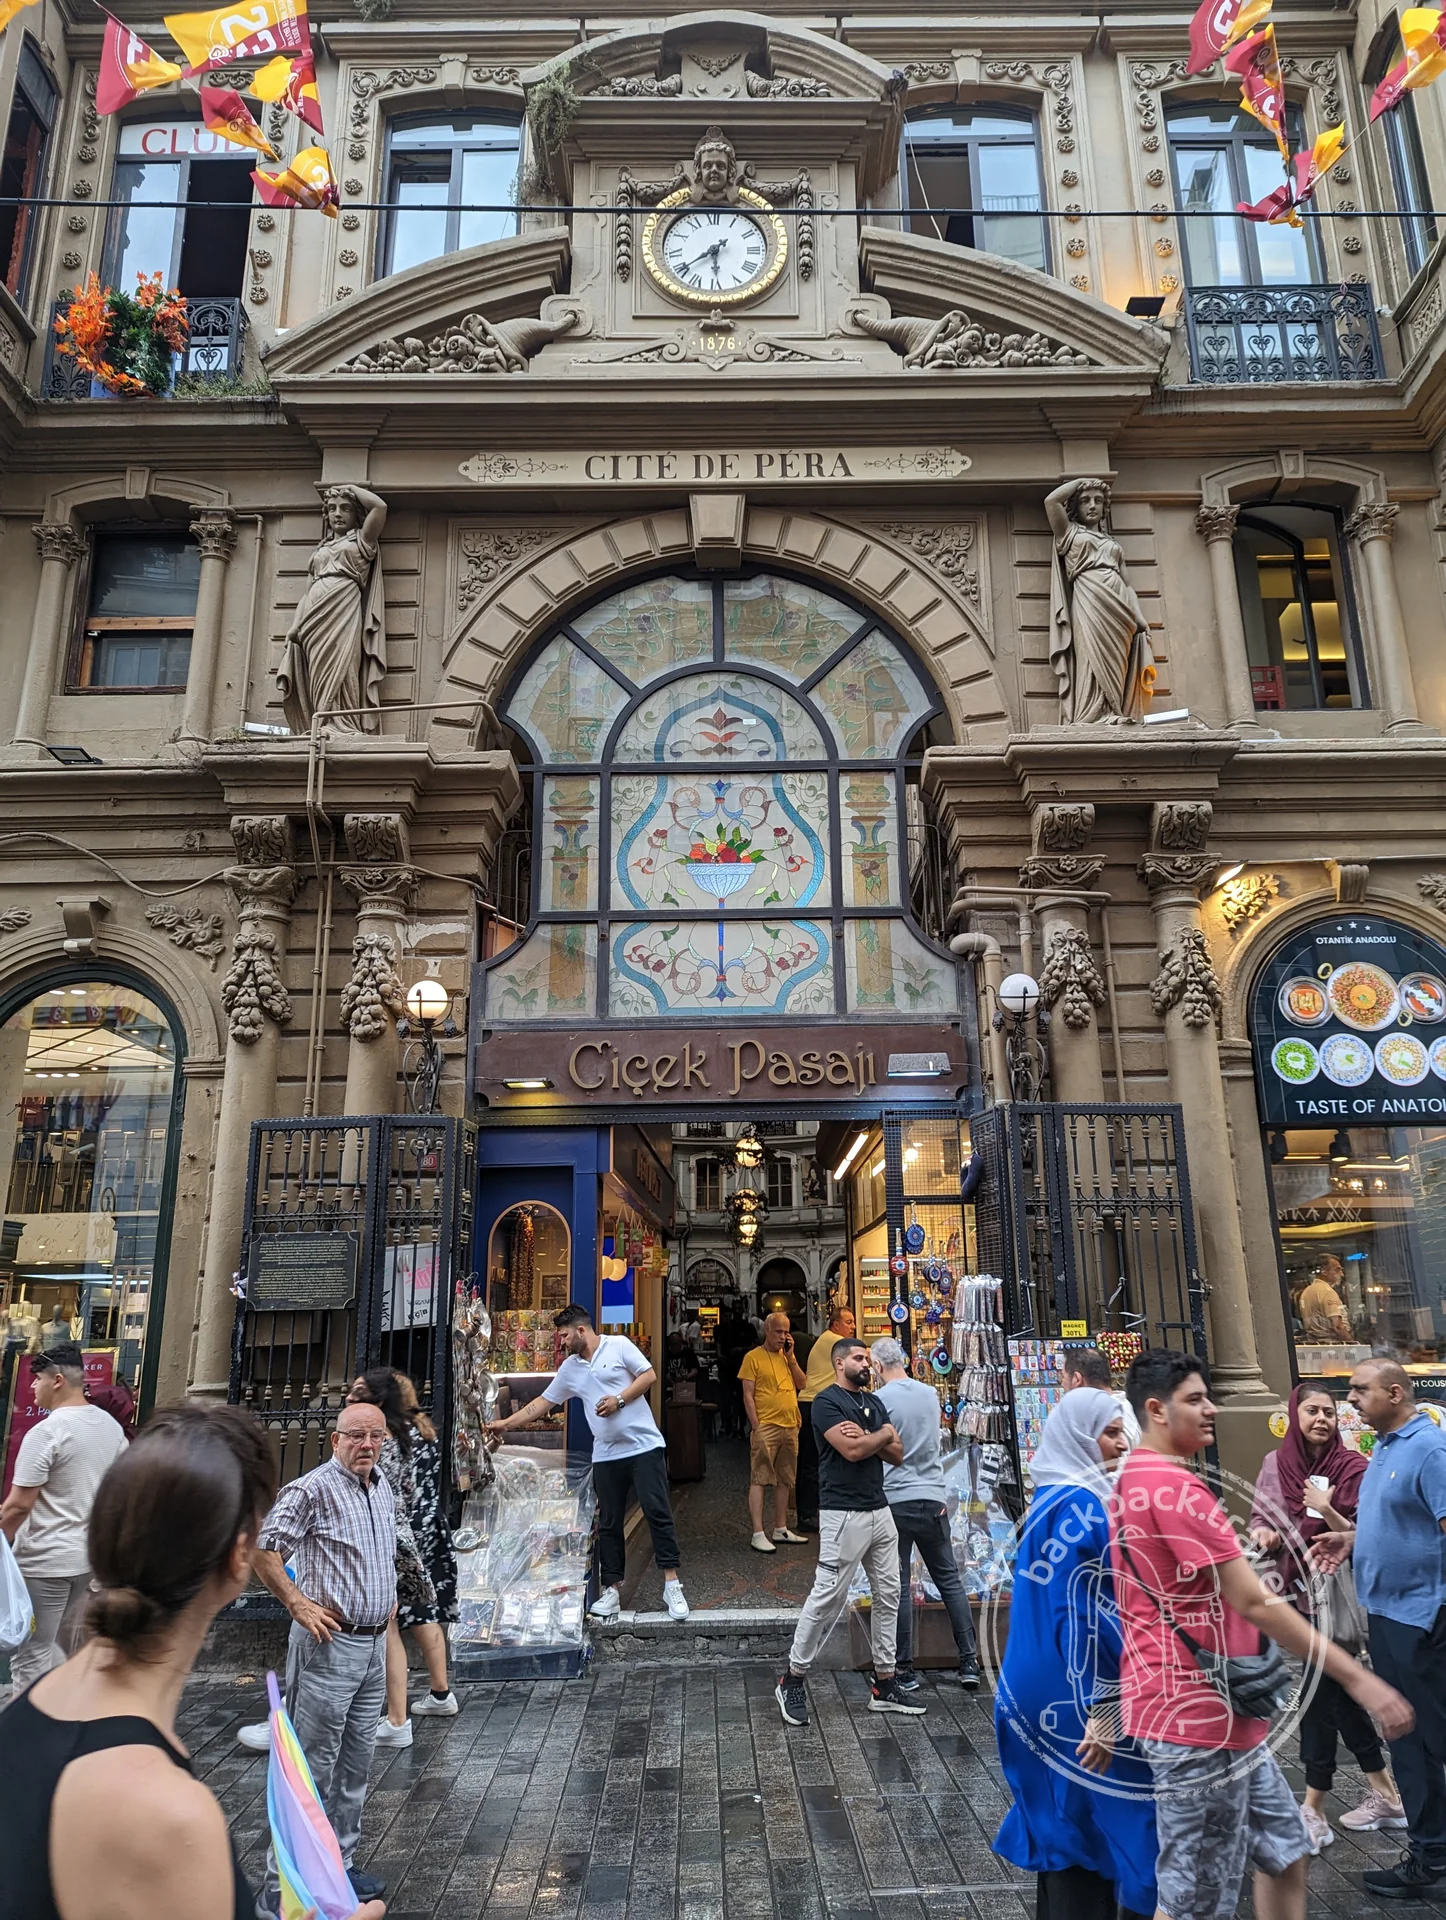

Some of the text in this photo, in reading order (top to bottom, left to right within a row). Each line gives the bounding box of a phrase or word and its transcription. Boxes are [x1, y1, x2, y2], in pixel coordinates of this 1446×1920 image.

[699, 336, 736, 351] 1876
[584, 450, 856, 480] CITÉ DE PÉRA
[1315, 935, 1397, 945] OTANTİK ANADOLU
[1295, 1099, 1349, 1114] TASTE
[1352, 1099, 1376, 1114] OF
[83, 1363, 103, 1371] KER
[25, 1406, 35, 1417] 2.
